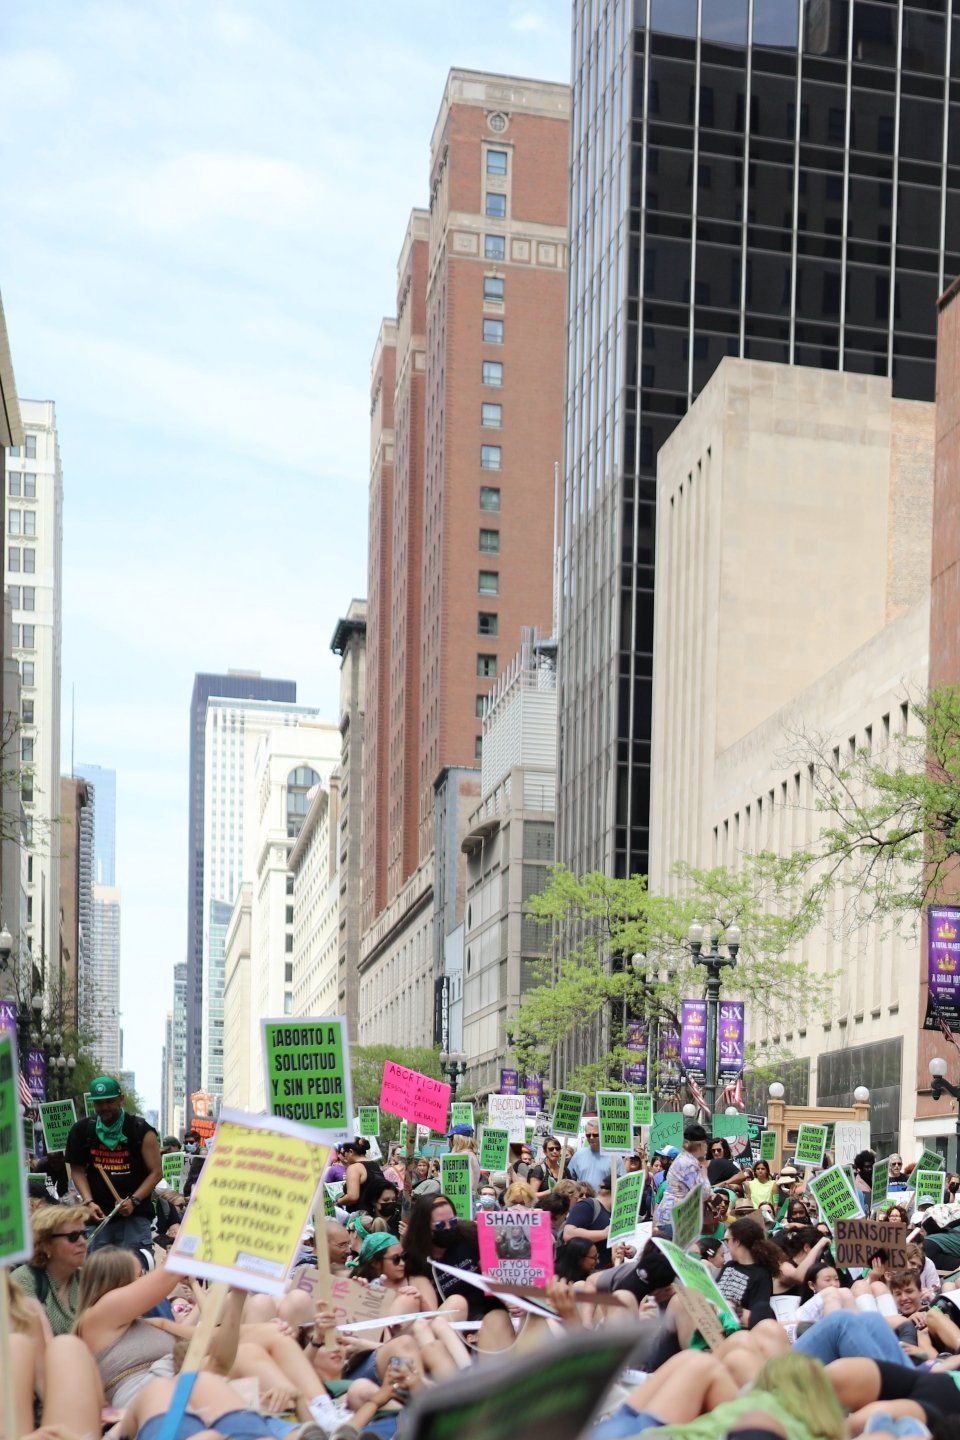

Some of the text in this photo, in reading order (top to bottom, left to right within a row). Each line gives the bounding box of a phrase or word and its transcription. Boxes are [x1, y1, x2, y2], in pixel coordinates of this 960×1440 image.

[721, 1007, 742, 1020] SIX
[272, 1027, 335, 1048] ¡ABORTO A
[721, 1042, 741, 1055] SIX
[275, 1052, 336, 1072] SOLICITUD
[389, 1065, 441, 1093] ABORTION
[271, 1076, 342, 1096] Y SIN PEDIR
[602, 1097, 626, 1107] ABORTION
[41, 1103, 72, 1115] OVERTURN
[274, 1101, 344, 1120] DISCULPAS!
[607, 1110, 629, 1119] DEMAND
[50, 1113, 61, 1121] ROE
[47, 1121, 61, 1129] HELL
[606, 1123, 628, 1132] WITHOUT
[484, 1130, 508, 1139] OVERTURN
[650, 1122, 681, 1144] CHOOSE
[604, 1135, 626, 1144] APOLOGY
[214, 1157, 231, 1167] NO
[215, 1145, 308, 1168] NO GOING BACK
[443, 1160, 469, 1170] OVERTURN
[448, 1172, 458, 1182] ROE
[834, 1170, 840, 1178] A
[210, 1177, 308, 1205] ABORTION ON
[444, 1184, 457, 1195] HELL
[819, 1182, 845, 1201] SOLICITUD
[218, 1195, 281, 1216] DEMAND
[827, 1200, 836, 1211] SIN
[834, 1191, 852, 1205] PEDIR
[220, 1213, 290, 1237] WITHOUT
[486, 1213, 539, 1225] SHAME
[218, 1231, 289, 1254] APOLOGY!
[837, 1244, 865, 1264] OUR
[489, 1269, 542, 1277] VOTED FOR
[500, 1277, 533, 1286] ANY OF
